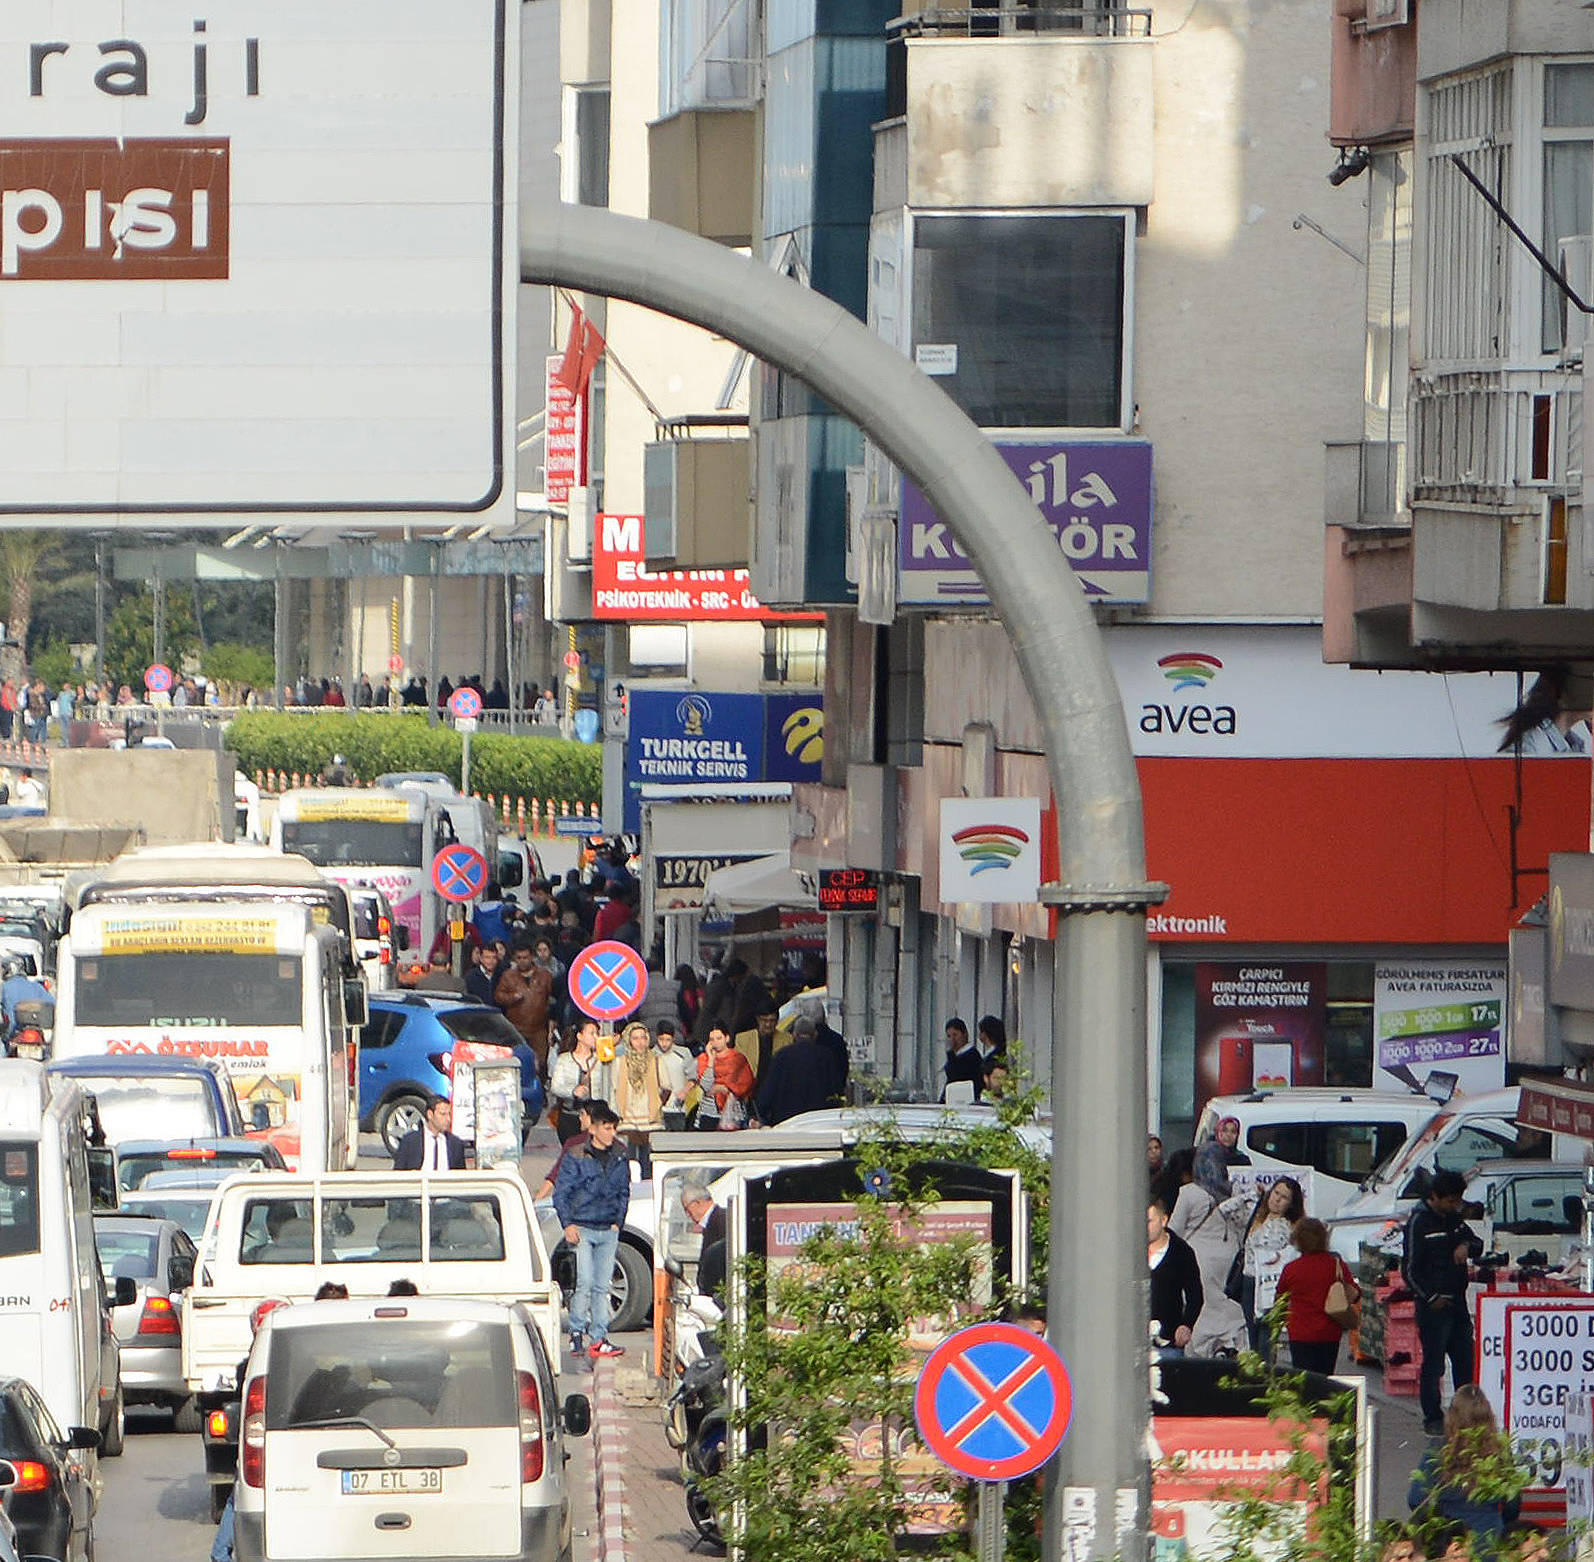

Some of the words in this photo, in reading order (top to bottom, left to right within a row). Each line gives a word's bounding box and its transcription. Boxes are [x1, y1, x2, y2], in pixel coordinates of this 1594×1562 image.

[1025, 452, 1117, 508] ila
[912, 516, 1138, 560] KÖR
[597, 589, 692, 609] PSİKOTEKNİK
[701, 591, 730, 609] SRC
[1139, 702, 1236, 736] avea
[640, 737, 748, 761] TURKCELL
[1146, 914, 1228, 934] ektronik
[1521, 1315, 1579, 1338] 3000
[1483, 1336, 1505, 1357] CE
[1515, 1349, 1573, 1373] 3000
[1522, 1384, 1570, 1407] 3GB
[1514, 1415, 1566, 1429] VODAFO
[351, 1473, 369, 1489] 07
[380, 1472, 409, 1488] ETL
[420, 1471, 439, 1487] 38
